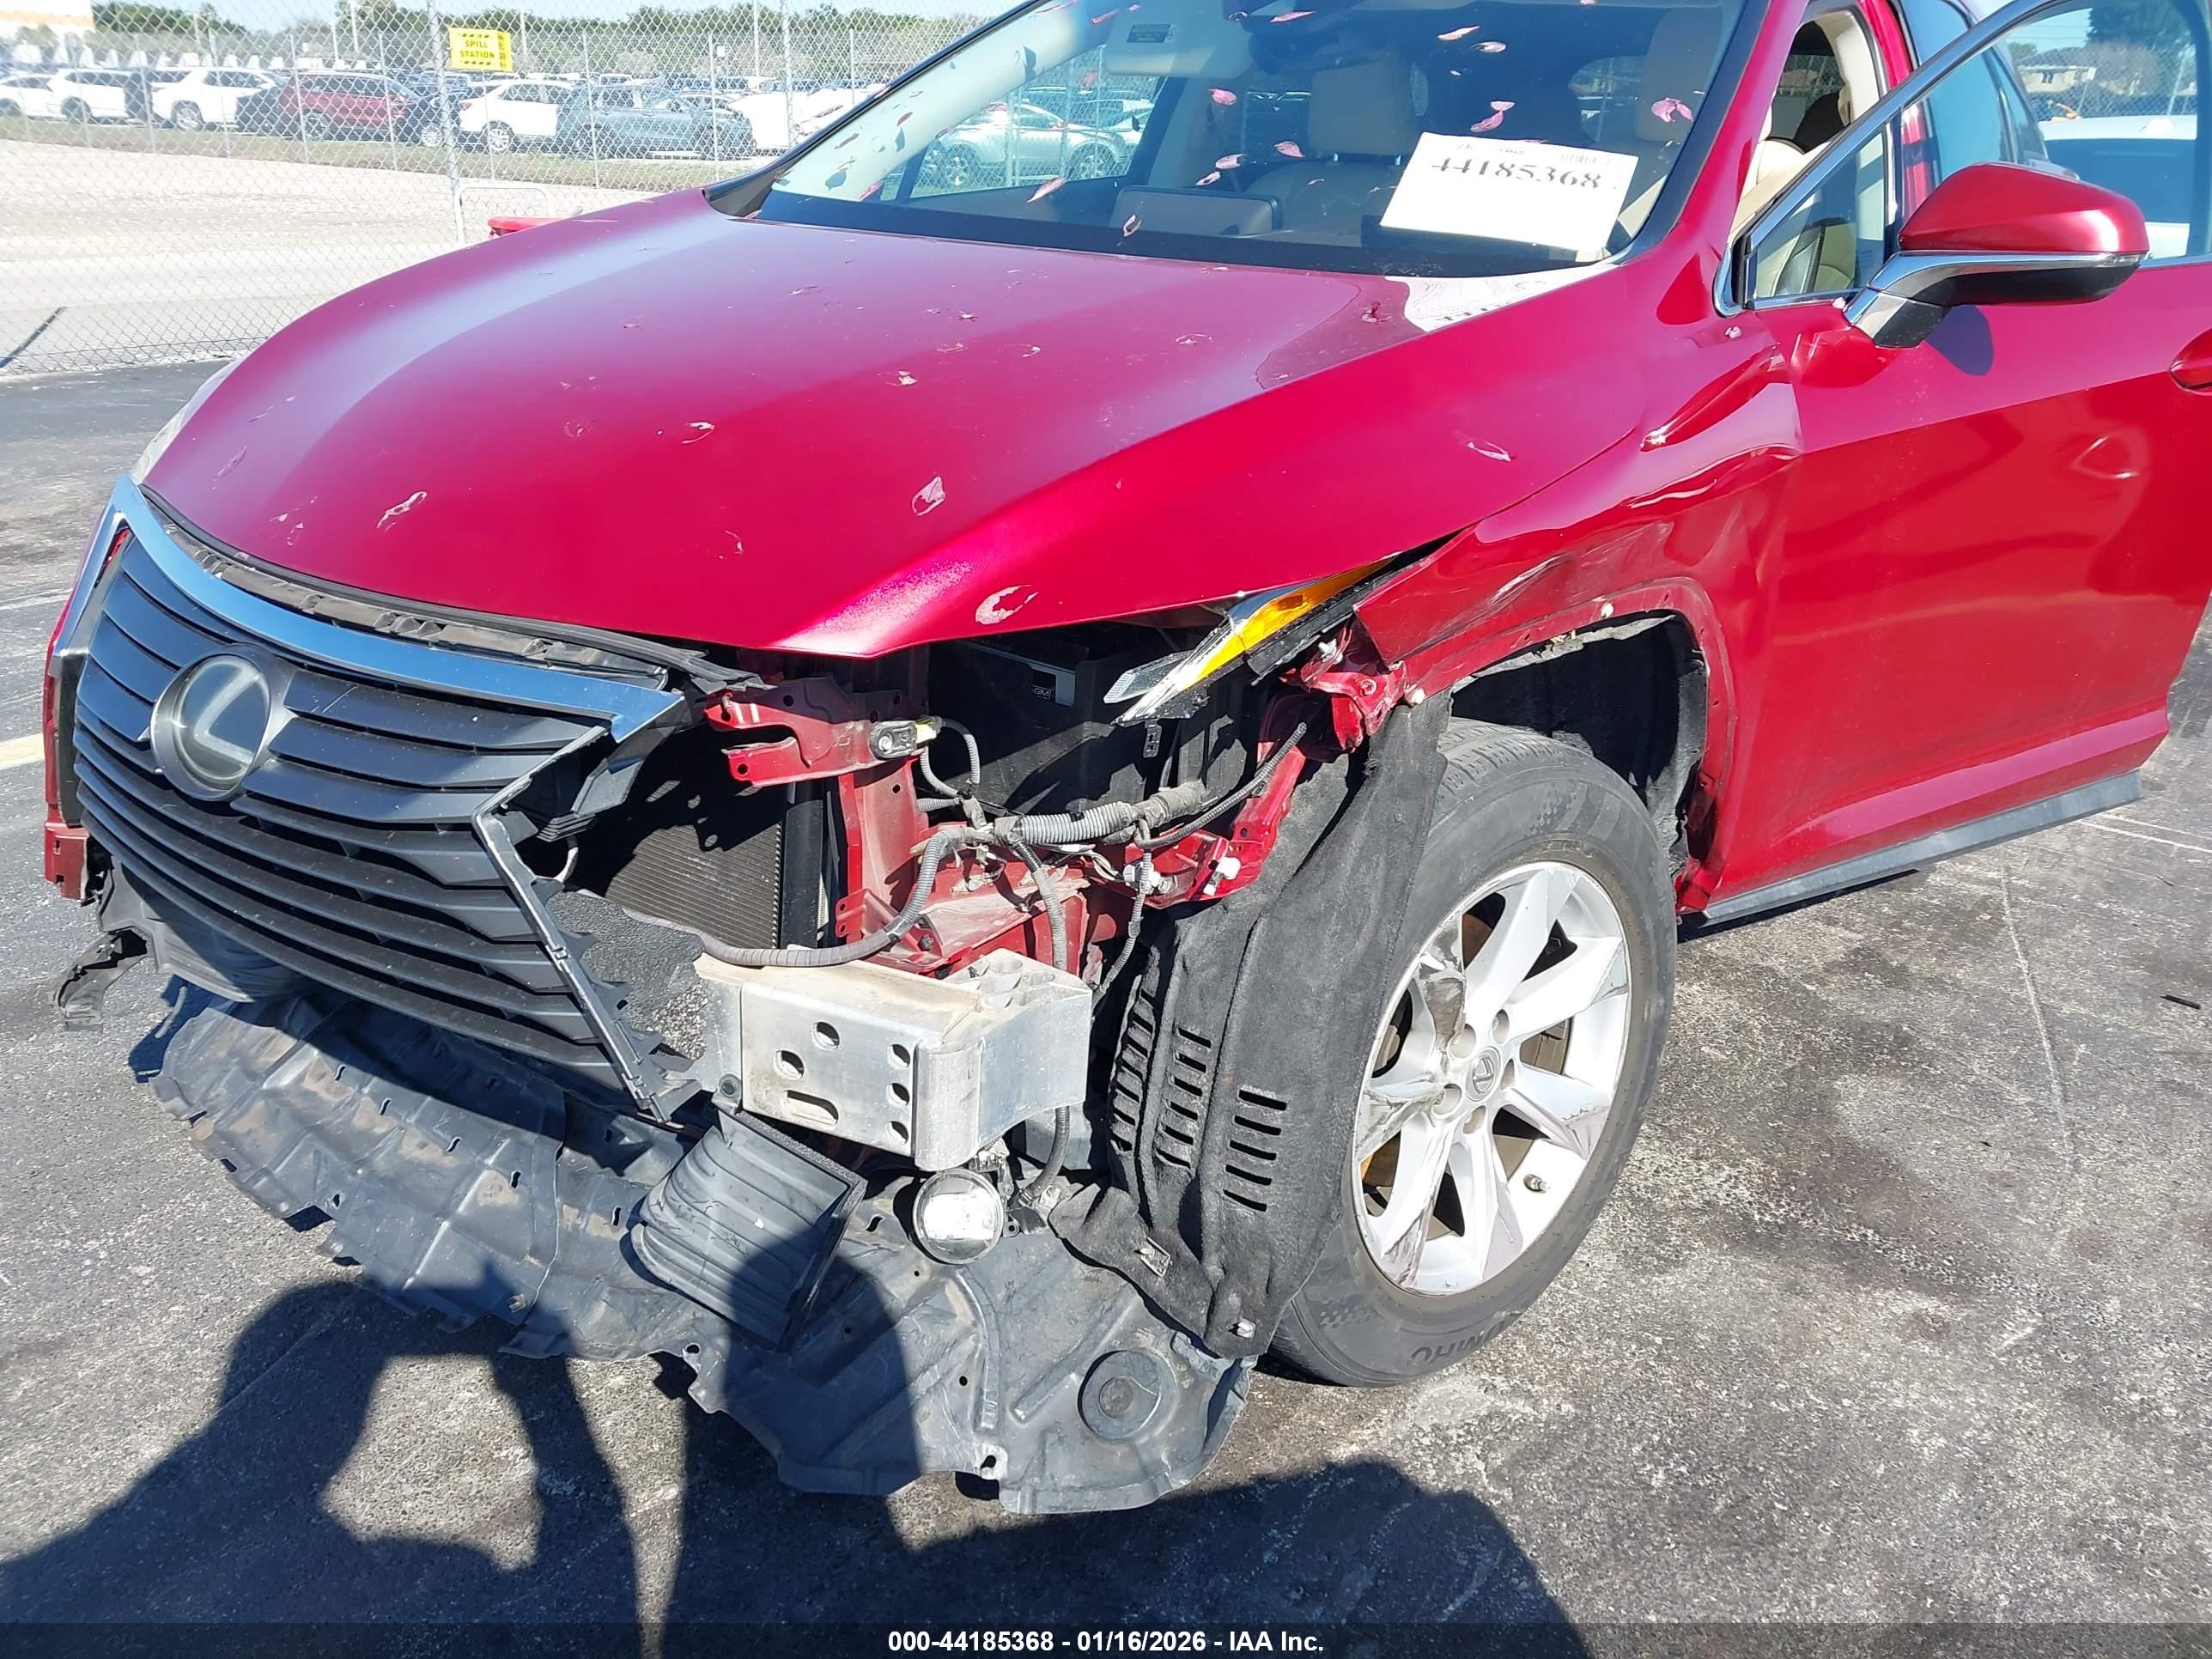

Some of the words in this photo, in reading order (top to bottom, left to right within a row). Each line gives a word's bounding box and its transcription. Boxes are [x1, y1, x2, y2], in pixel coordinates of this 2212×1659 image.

[465, 40, 489, 48] SPILL
[459, 50, 495, 59] STATION
[1431, 157, 1601, 189] 44185368
